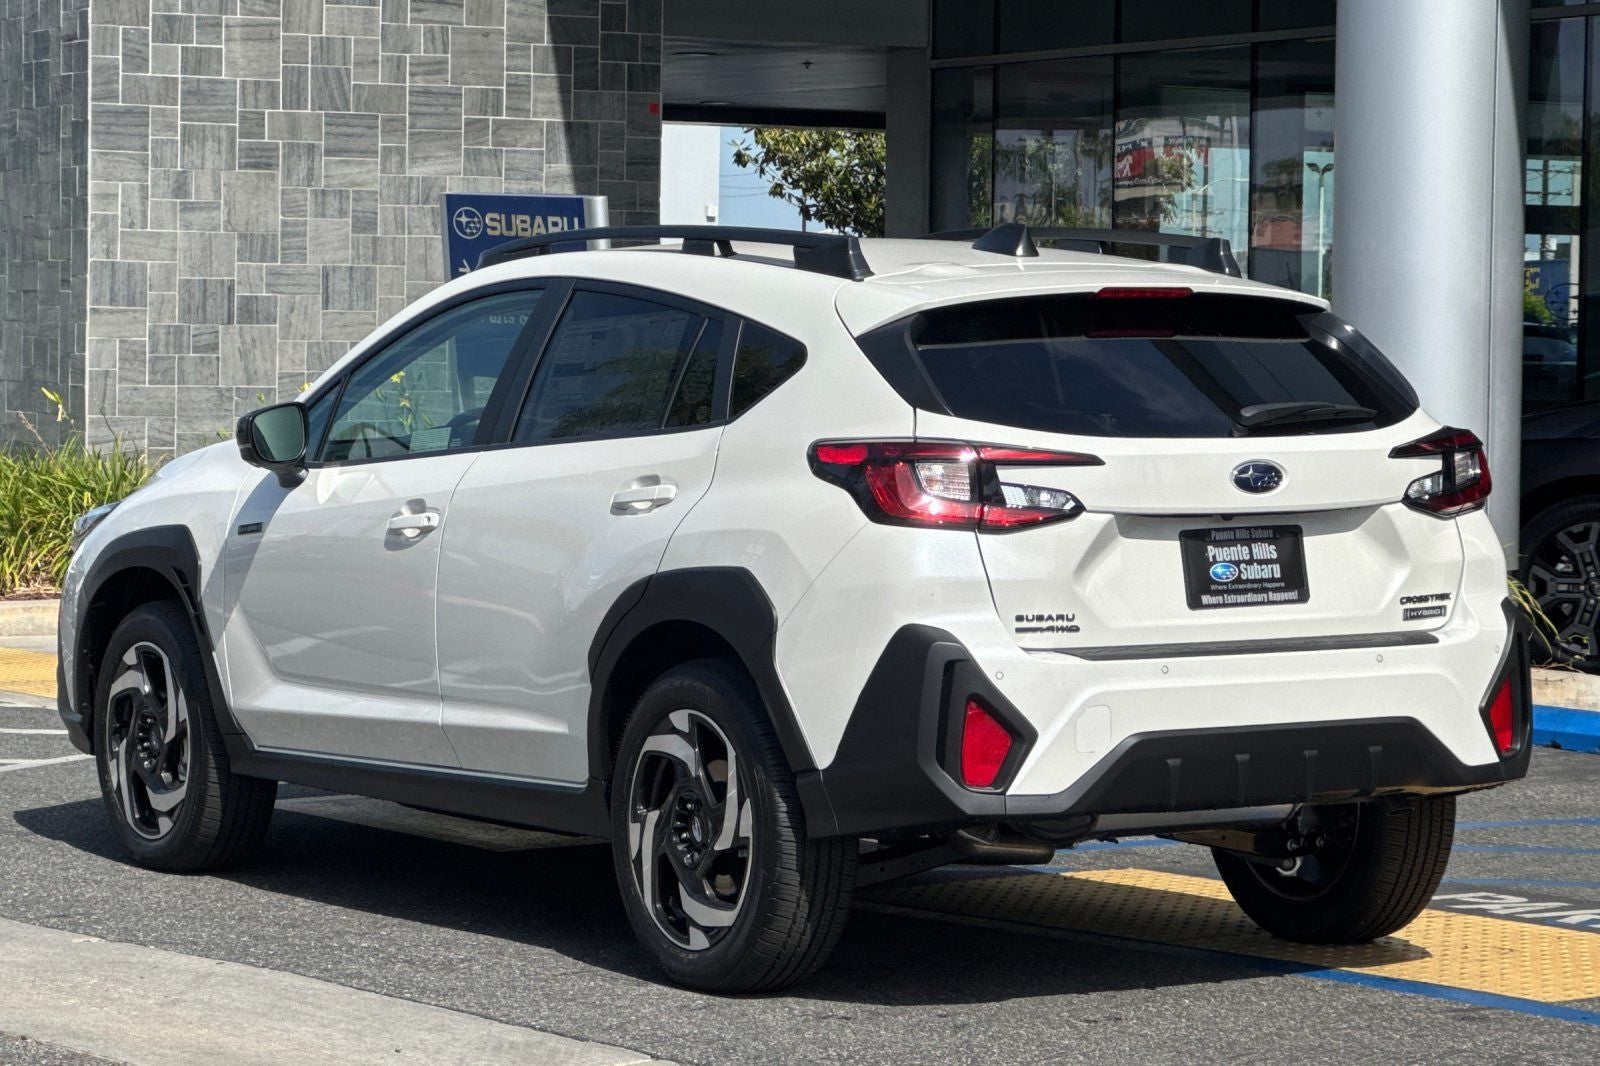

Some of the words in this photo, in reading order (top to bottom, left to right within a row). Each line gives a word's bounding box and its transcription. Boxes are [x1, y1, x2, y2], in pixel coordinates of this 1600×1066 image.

[485, 212, 579, 237] SUBARU
[1211, 531, 1235, 540] Puente
[1235, 530, 1250, 539] Hills
[1207, 544, 1250, 561] Puente
[1251, 542, 1277, 560] Hills
[1240, 563, 1281, 580] Subaru
[1228, 582, 1262, 590] Extraordinary
[1262, 580, 1284, 588] Happens
[1201, 594, 1223, 605] Where
[1224, 592, 1268, 604] Extraordinary
[1015, 614, 1075, 622] SUBARU
[1410, 609, 1441, 617] HYBRID
